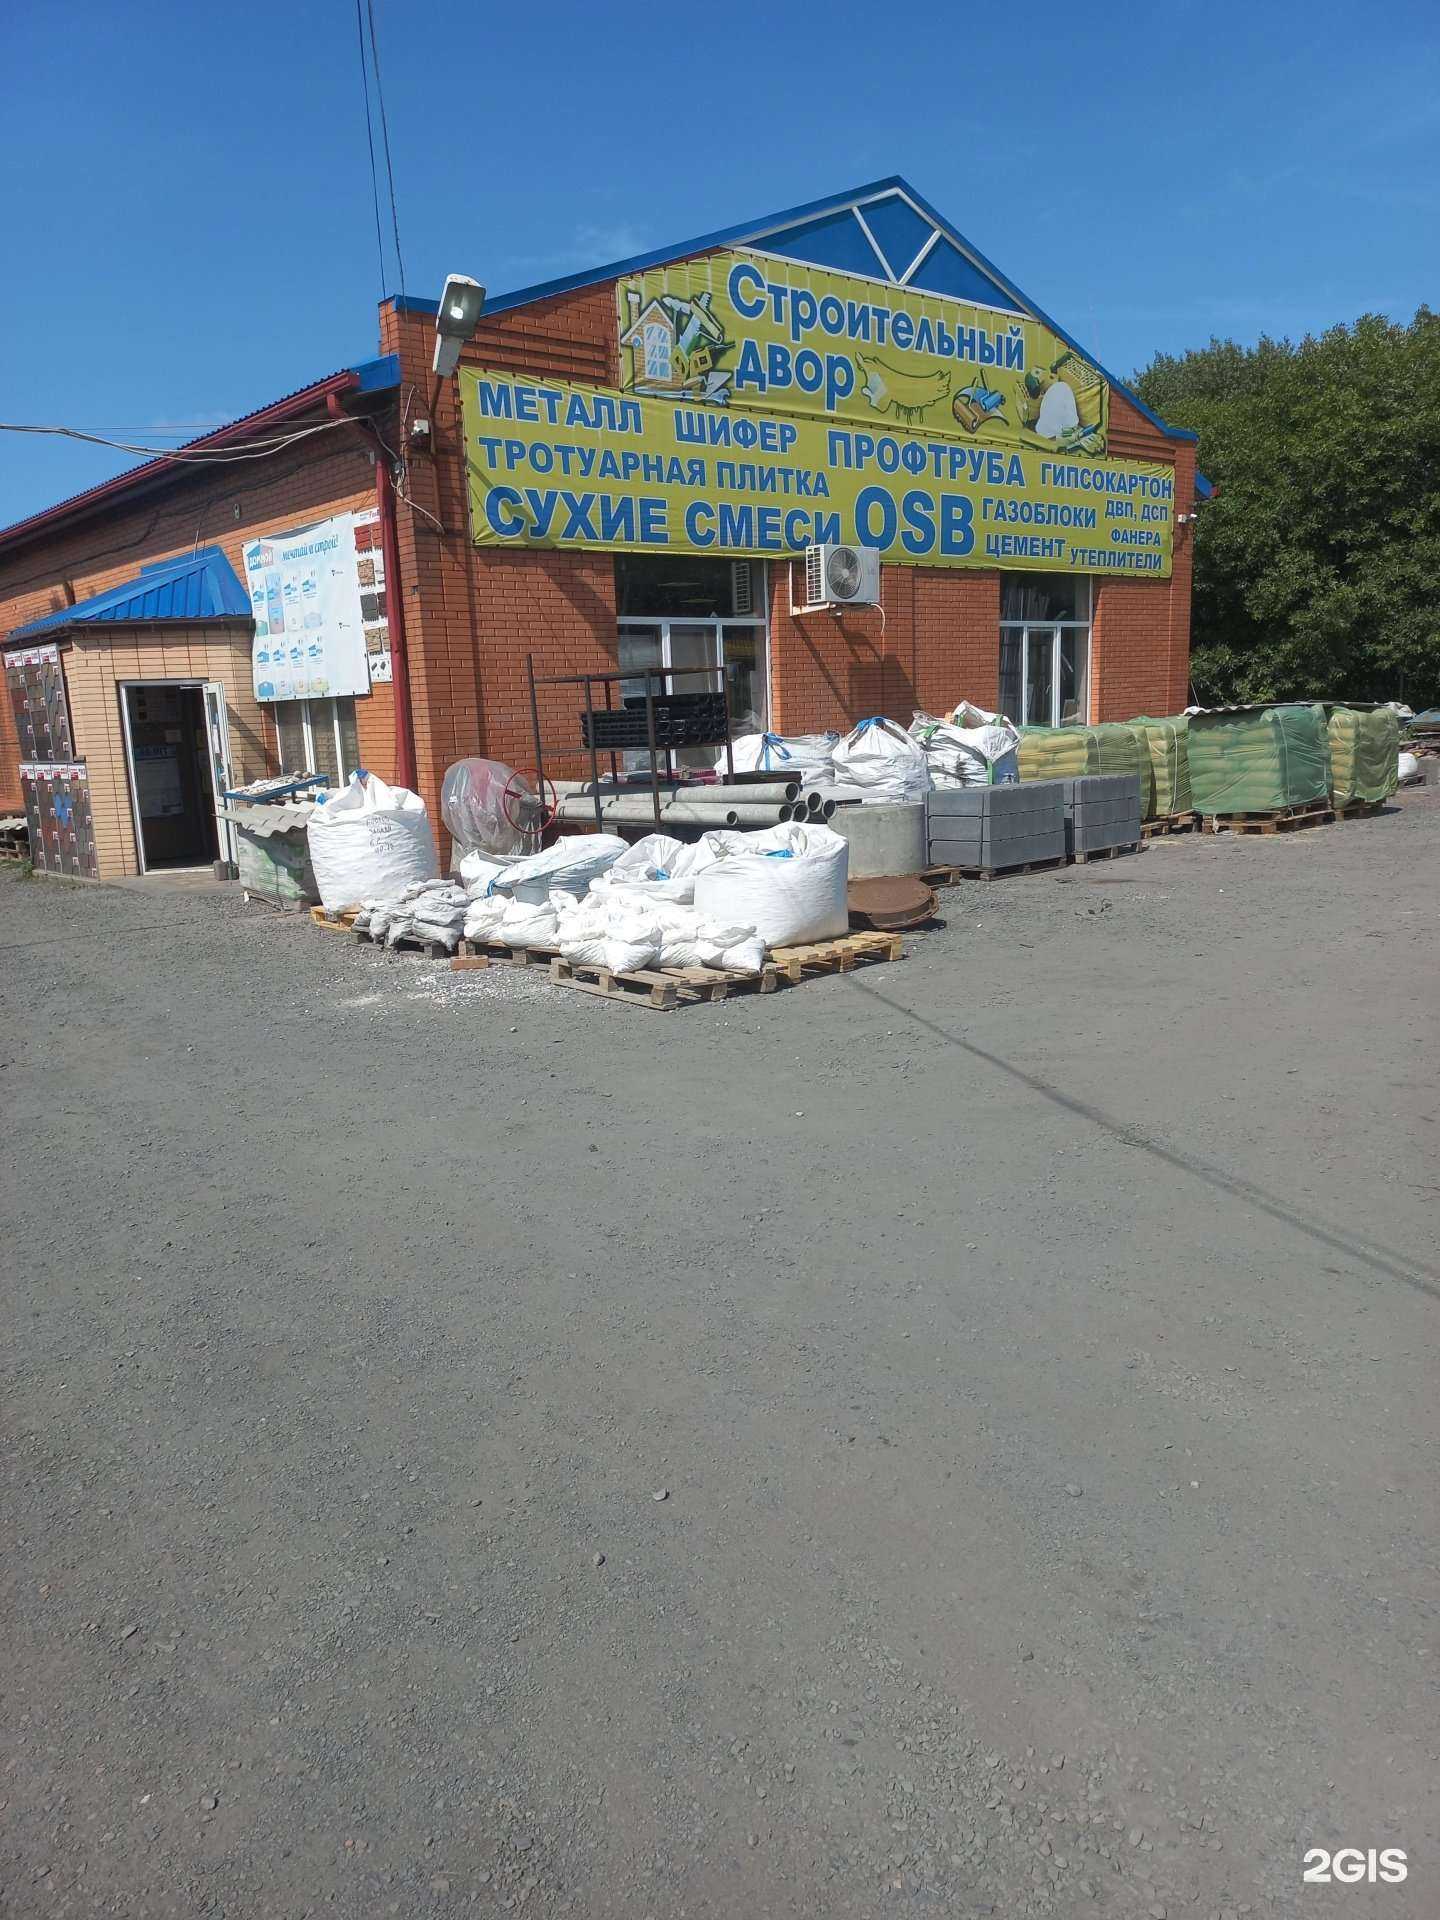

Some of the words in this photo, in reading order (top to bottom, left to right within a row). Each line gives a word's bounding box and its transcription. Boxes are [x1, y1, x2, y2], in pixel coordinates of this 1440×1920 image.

[727, 263, 1025, 372] Строительный
[478, 381, 644, 434] МЕТАЛЛ
[674, 409, 798, 454] ШИФЕР
[478, 436, 706, 487] ТРОТУАРНАЯ
[717, 461, 831, 497] ПЛИТКА
[827, 430, 1025, 488] ПРОФТРУБА
[1041, 462, 1173, 500] ГИПСОКАРТОН
[484, 485, 670, 545] СУХИЕ
[685, 501, 841, 551] СМЕСИ
[854, 485, 975, 556] OSB
[981, 497, 1097, 529] ГАЗОБЛОКИ
[1140, 504, 1168, 522] ДСП
[985, 534, 1066, 559] ЦЕМЕНТ
[1070, 546, 1163, 571] УТЕПЛИТЕЛИ
[1110, 528, 1162, 547] ФАНЕРА
